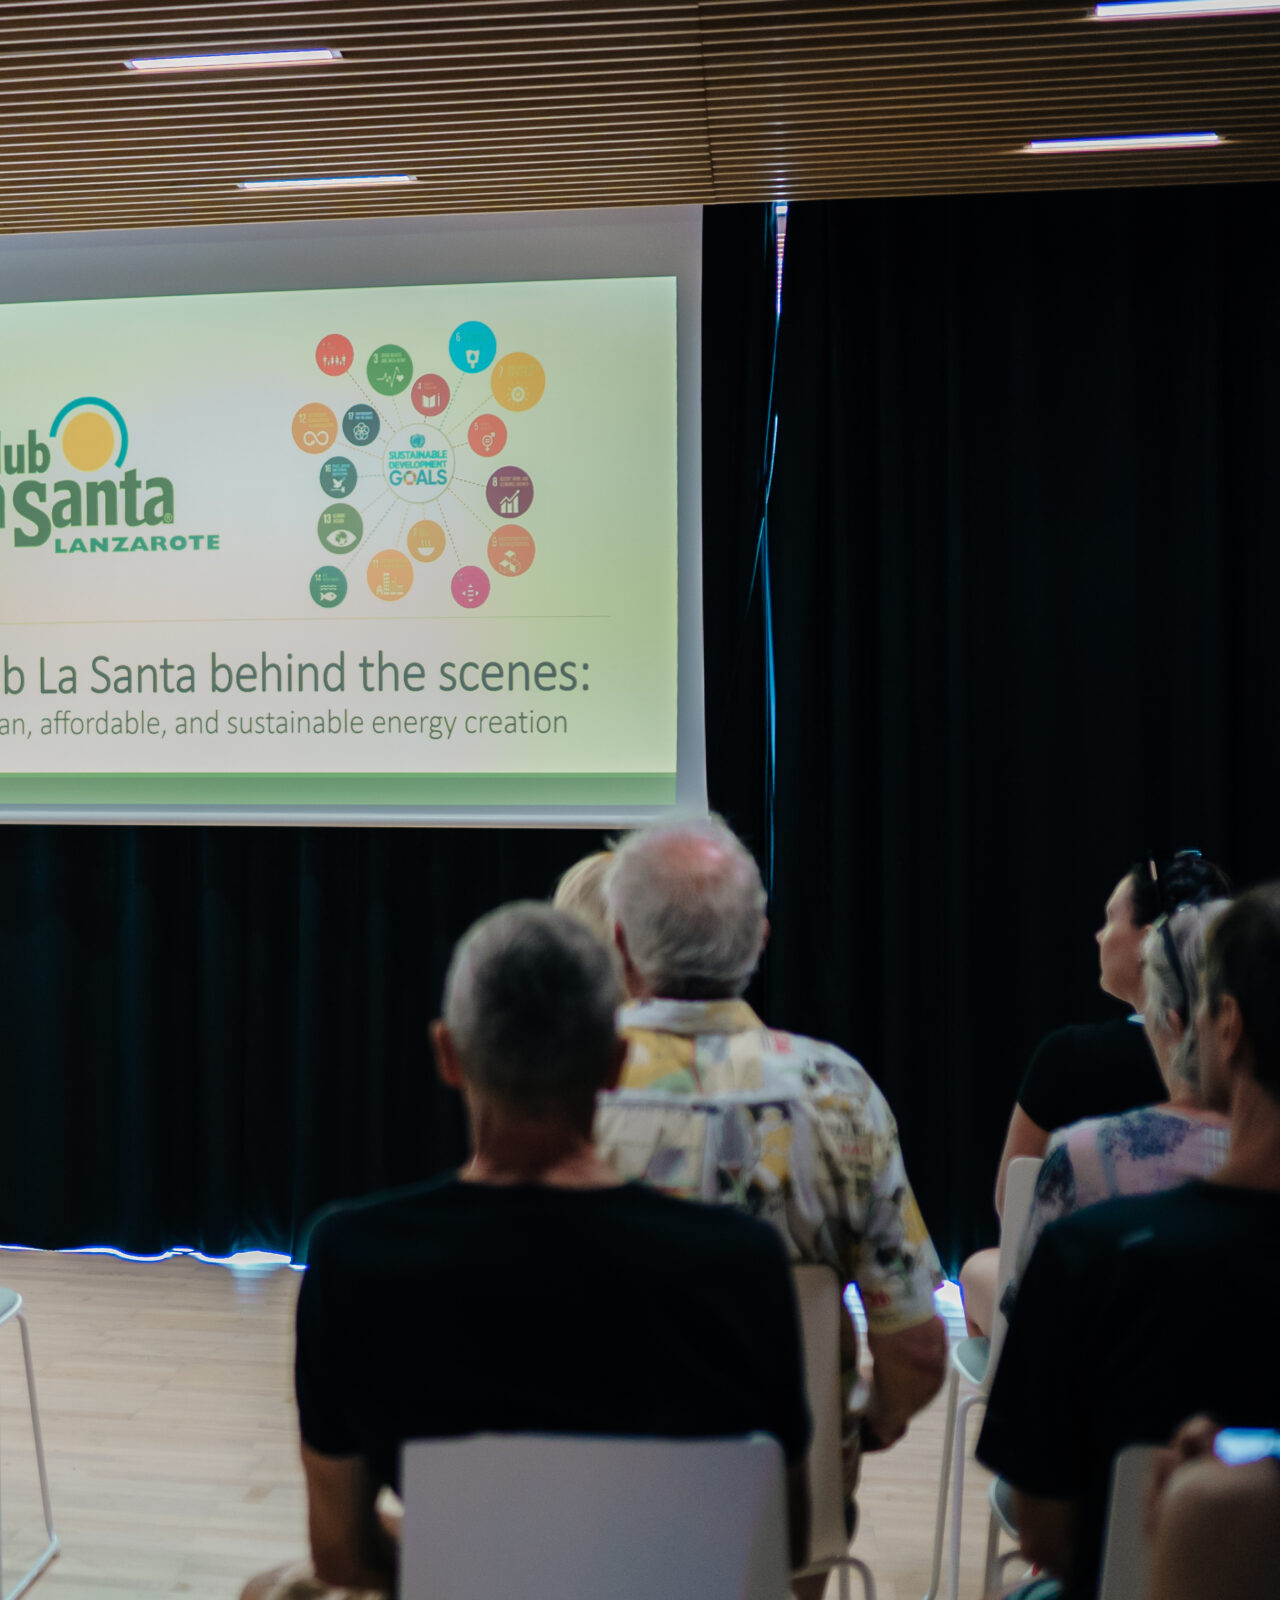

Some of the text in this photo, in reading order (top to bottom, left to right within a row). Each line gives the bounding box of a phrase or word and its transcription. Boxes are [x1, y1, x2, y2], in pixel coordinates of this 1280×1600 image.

[372, 353, 379, 364] 3
[388, 450, 448, 460] SUSTAINABLE
[388, 460, 448, 470] DEVELOPMENT
[389, 469, 448, 486] GOALS
[323, 513, 331, 524] 13
[54, 534, 220, 554] LANZAROTE
[39, 656, 77, 695] La
[90, 655, 196, 694] Santa
[211, 650, 345, 693] behind
[358, 650, 426, 692] the
[439, 660, 590, 692] scenes:
[40, 709, 167, 739] affordable,
[174, 709, 219, 735] and
[227, 708, 364, 735] sustainable
[372, 715, 457, 740] energy
[464, 710, 568, 734] creation
